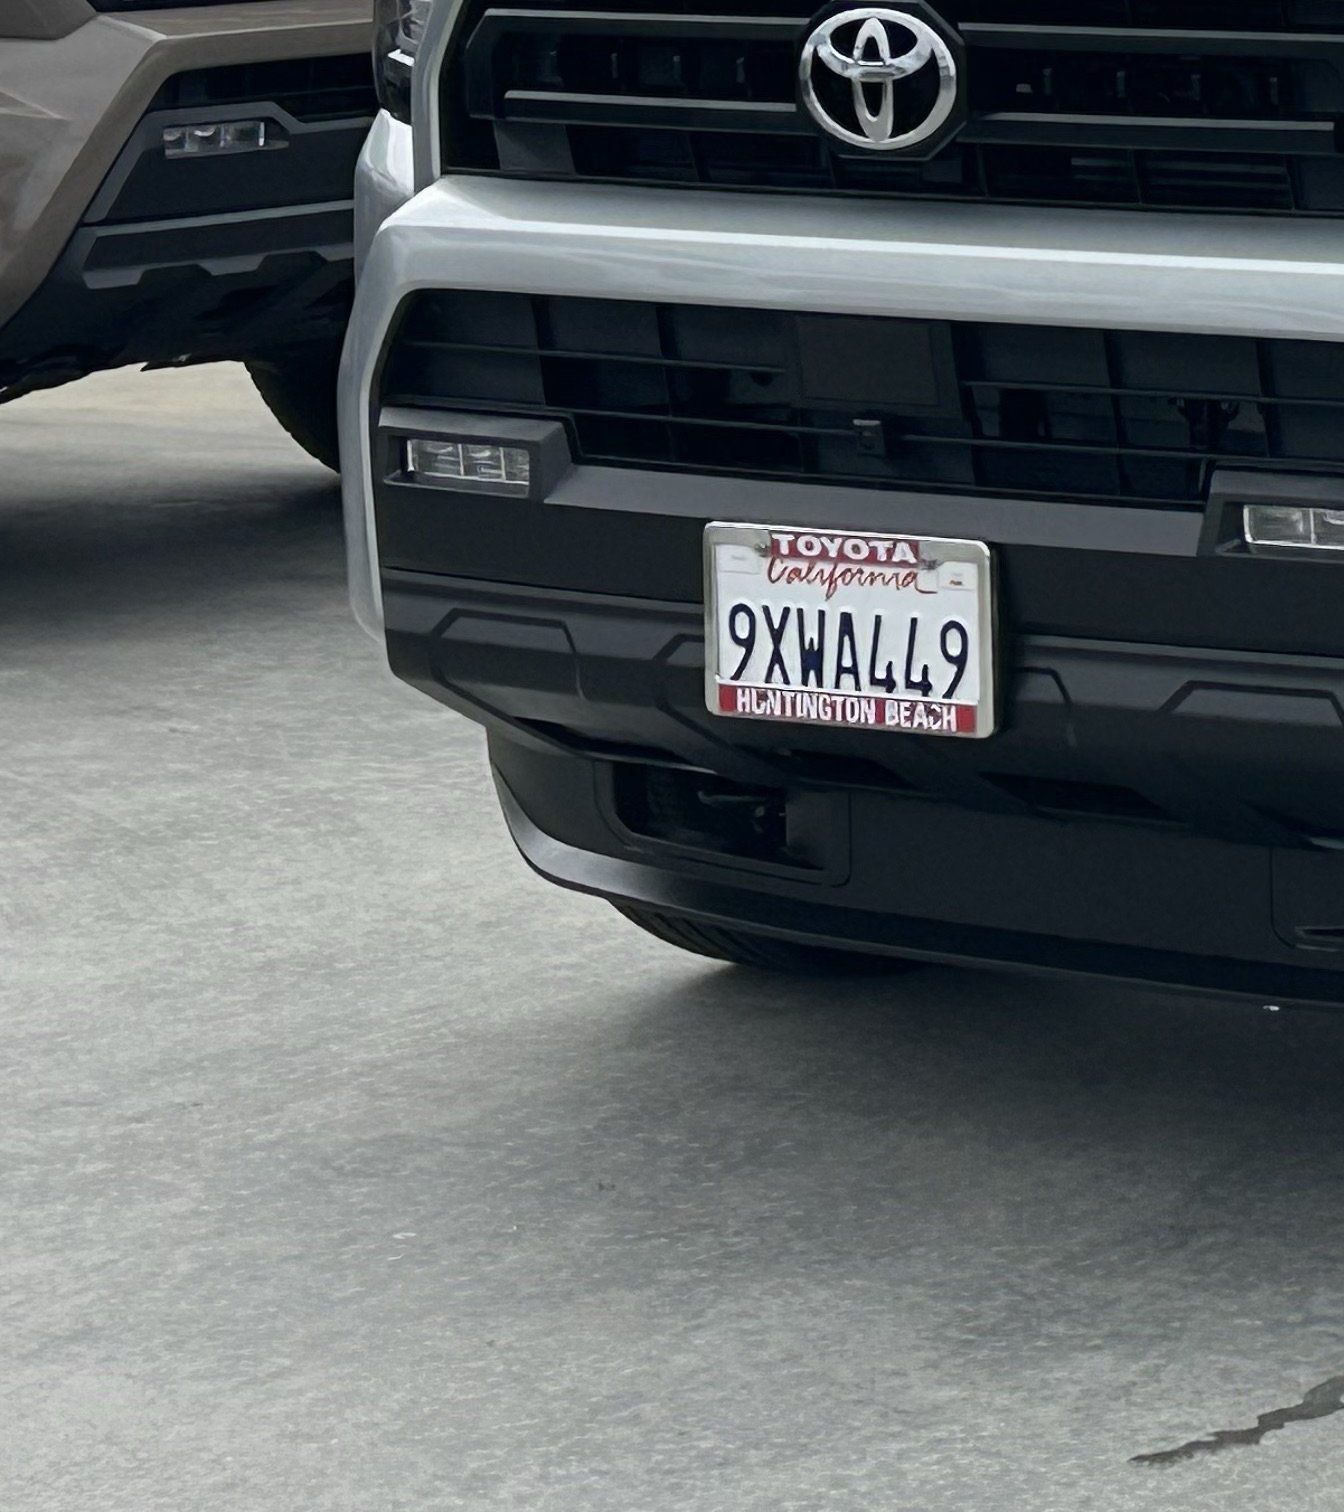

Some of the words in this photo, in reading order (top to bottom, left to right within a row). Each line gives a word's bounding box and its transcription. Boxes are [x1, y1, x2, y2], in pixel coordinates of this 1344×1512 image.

[770, 533, 918, 564] TOYOTA
[766, 557, 939, 601] California
[728, 603, 969, 700] 9XWA449
[736, 687, 876, 725] HUNTINGTON
[885, 702, 958, 733] BEACH
